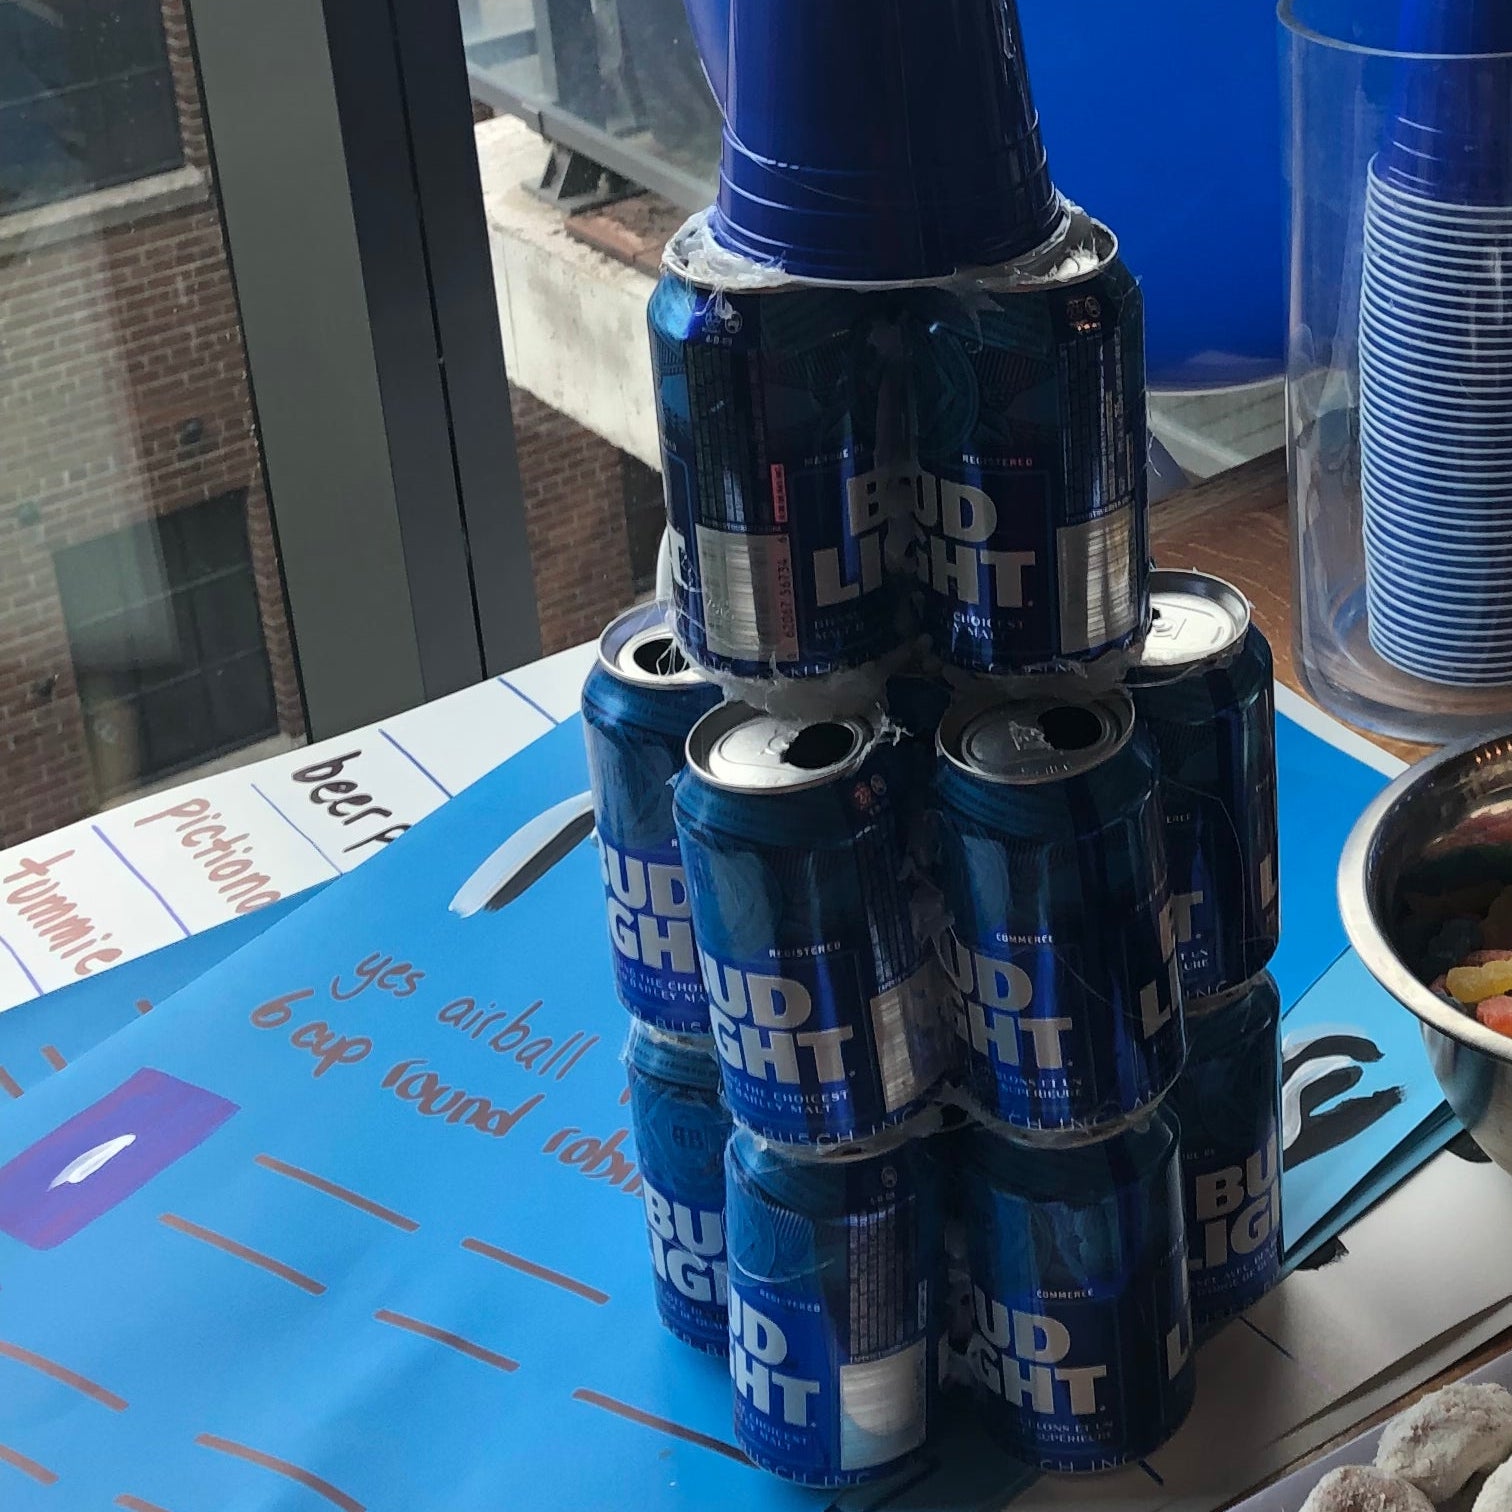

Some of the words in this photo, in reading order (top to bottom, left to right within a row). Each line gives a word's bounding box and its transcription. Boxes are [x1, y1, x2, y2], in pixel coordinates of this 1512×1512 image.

[292, 748, 393, 833] beer
[603, 843, 692, 919] UD
[697, 946, 811, 1030] UD
[768, 941, 842, 959] REGISTERED
[949, 935, 1033, 1013] UD
[332, 950, 425, 1002] yes
[437, 996, 600, 1080] airball
[709, 1003, 855, 1085] GHT
[250, 988, 315, 1030] 6
[289, 1016, 372, 1079] cup
[380, 1058, 546, 1138] round
[642, 1174, 724, 1258] BU
[1196, 1138, 1278, 1223] BU
[728, 1285, 788, 1368] UD
[973, 1283, 1070, 1365] UD
[966, 1333, 1107, 1417] GHT
